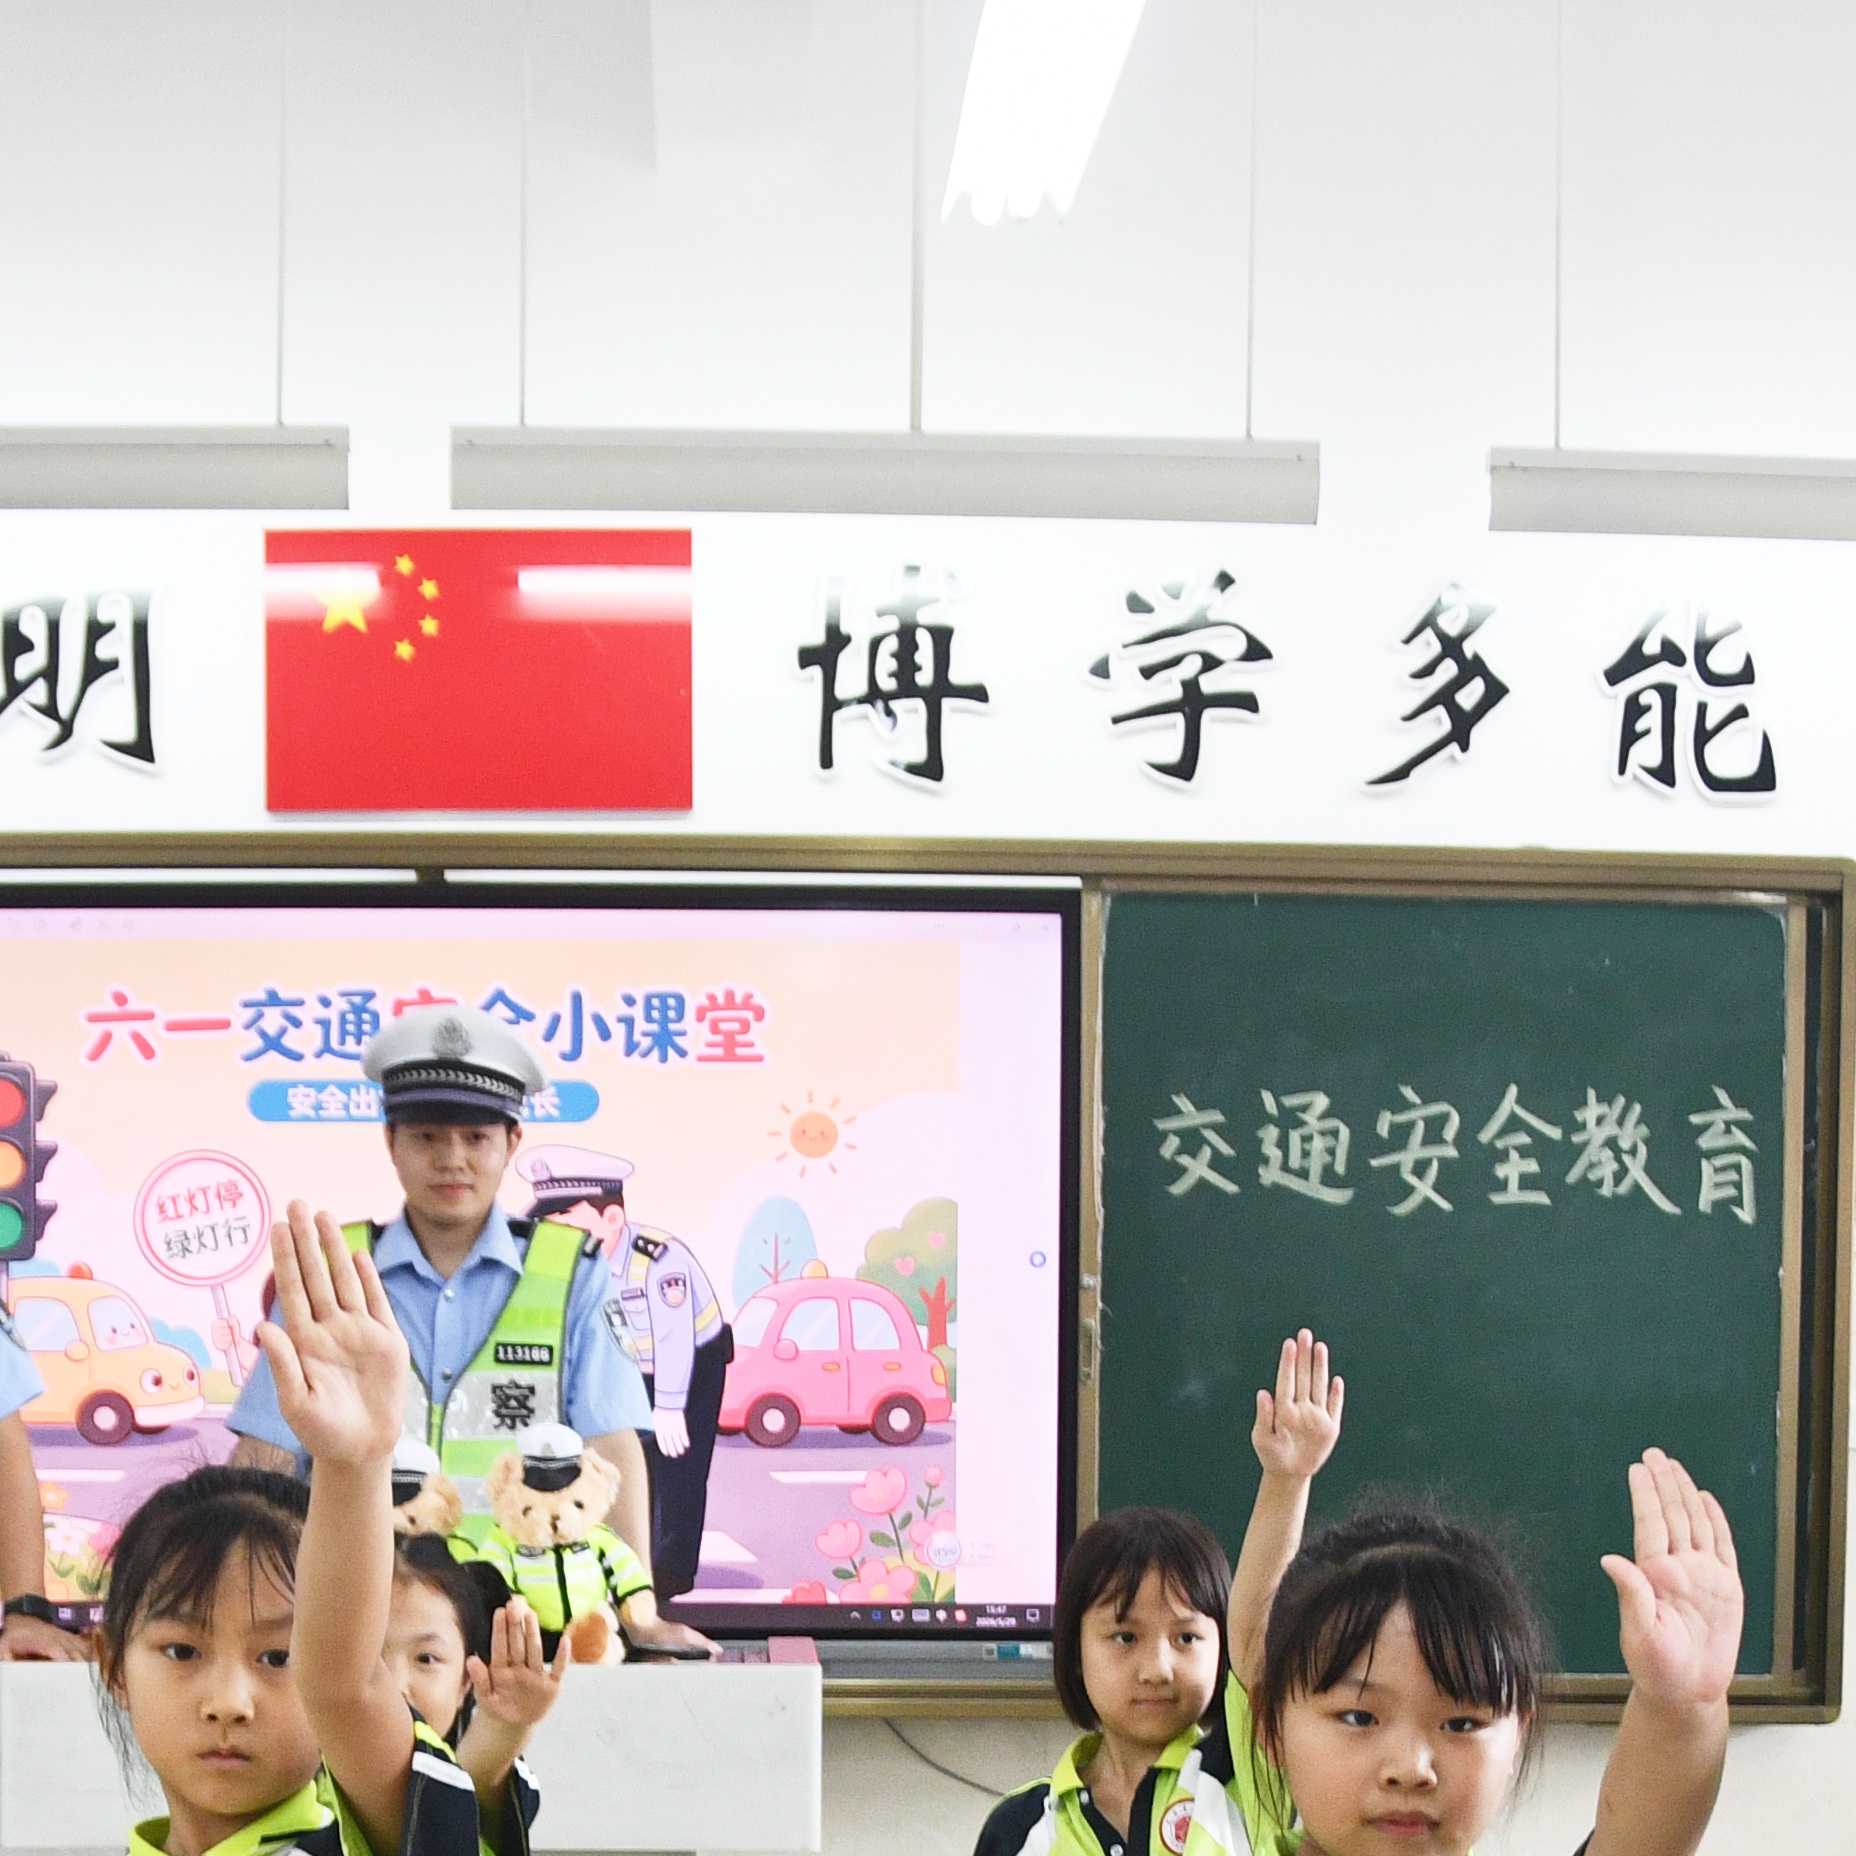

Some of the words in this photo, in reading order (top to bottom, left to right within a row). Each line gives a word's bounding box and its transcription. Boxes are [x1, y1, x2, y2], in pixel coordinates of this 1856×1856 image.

[797, 564, 1780, 797] 博学多能
[1152, 1083, 1762, 1225] 交通安全教育
[155, 1179, 244, 1224] 红灯停
[163, 1215, 251, 1260] 绿灯行
[490, 1378, 536, 1430] 察
